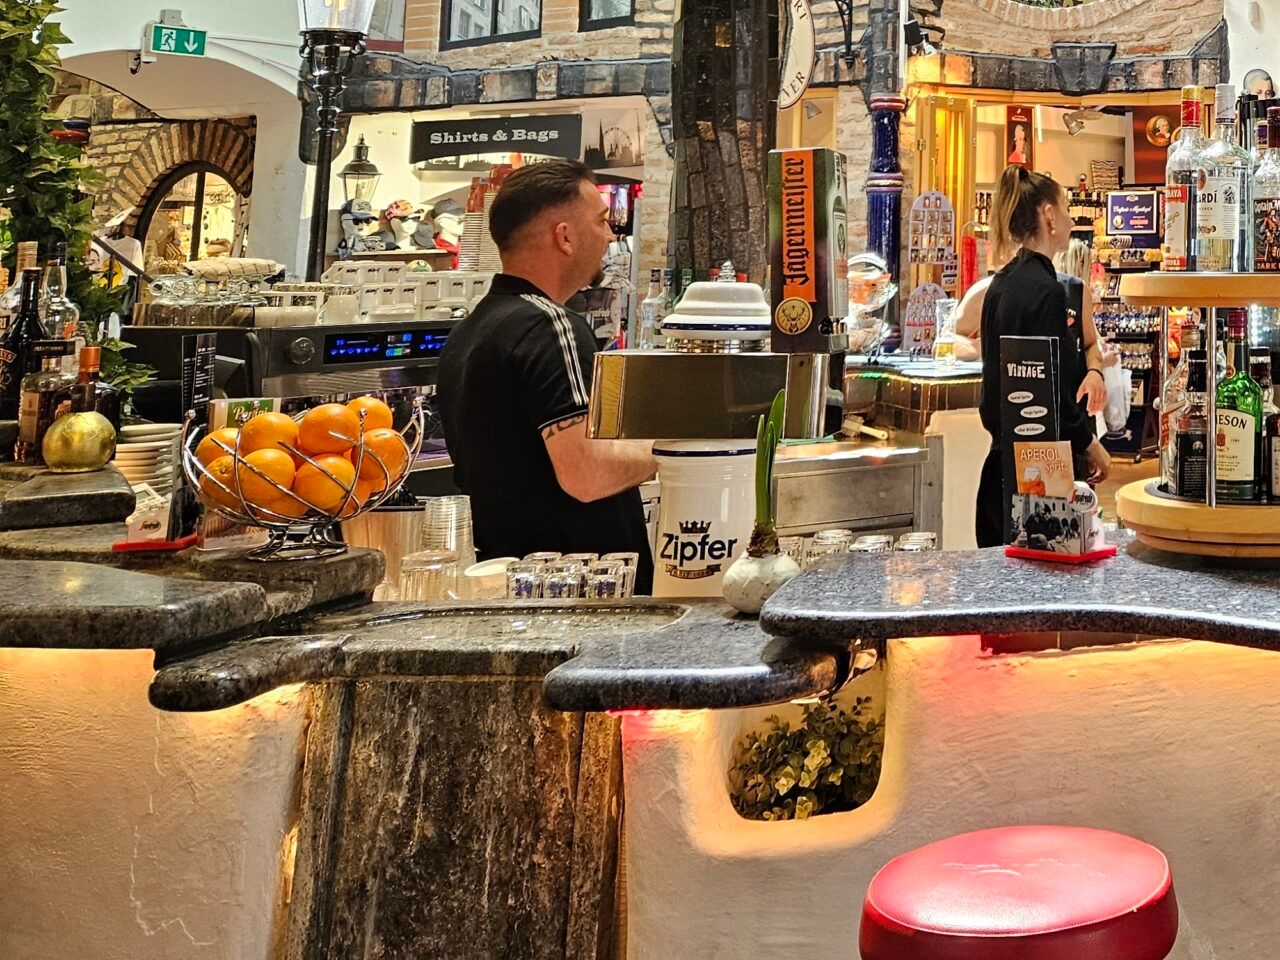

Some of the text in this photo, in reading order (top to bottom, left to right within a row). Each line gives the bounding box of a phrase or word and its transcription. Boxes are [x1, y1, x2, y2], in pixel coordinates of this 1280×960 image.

[430, 129, 558, 144] Shirts & Bags
[1257, 262, 1276, 270] DARK
[1020, 449, 1061, 460] APEROL
[660, 533, 738, 567] Zipfer
